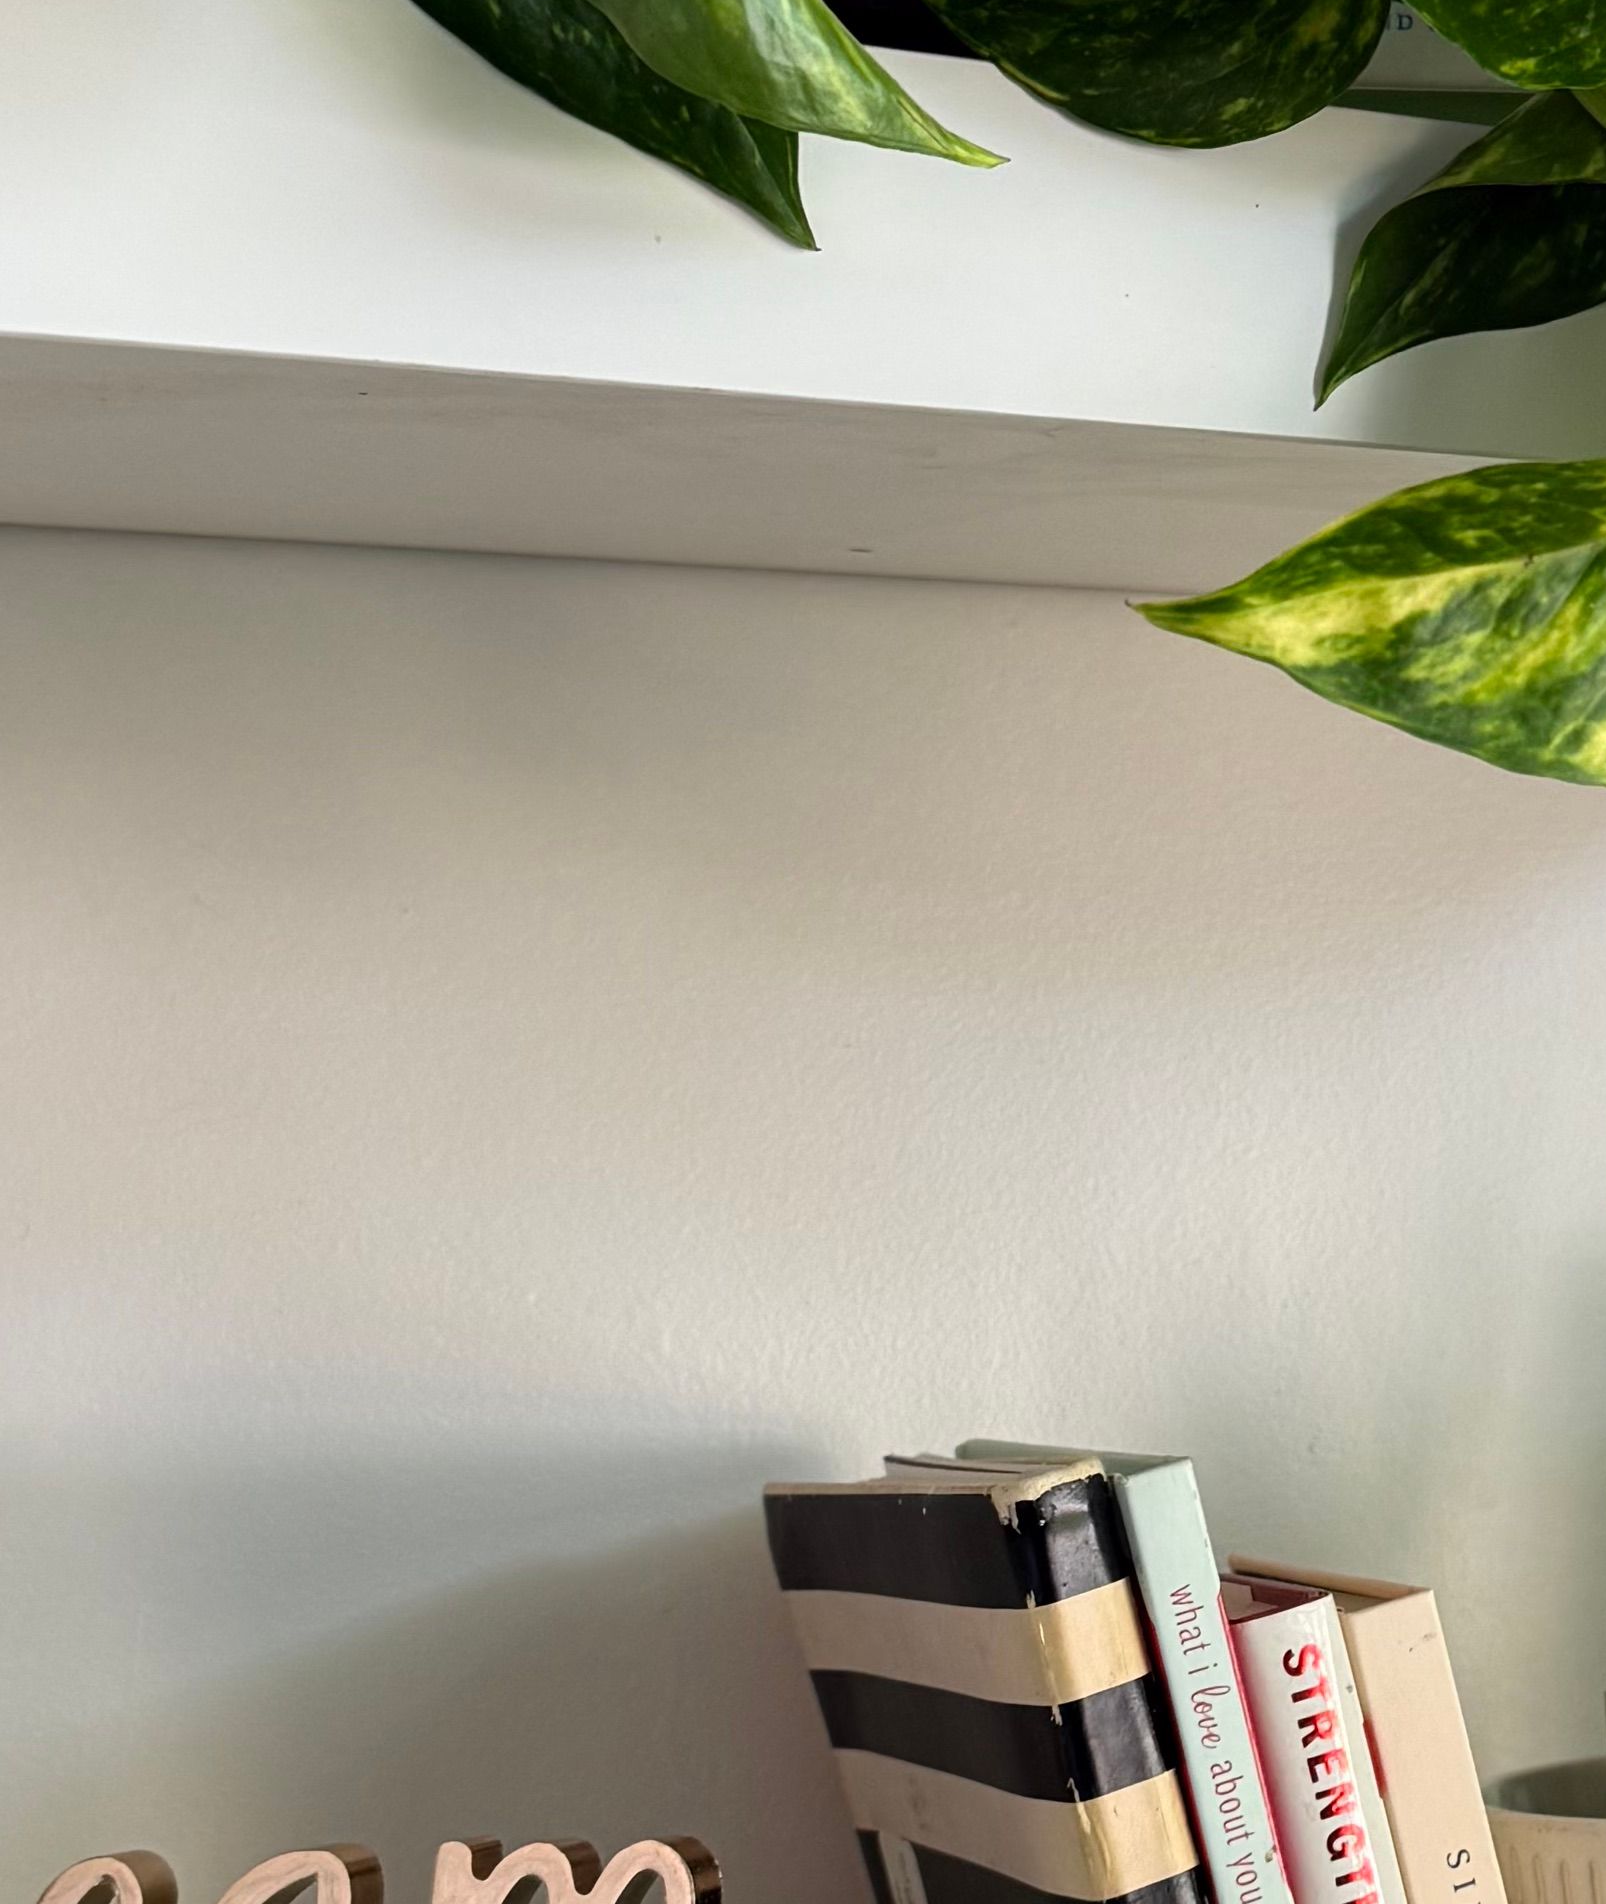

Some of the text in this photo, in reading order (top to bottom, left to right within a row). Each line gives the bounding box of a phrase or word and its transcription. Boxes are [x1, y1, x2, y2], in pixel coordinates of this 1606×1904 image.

[1170, 1584, 1211, 1656] what
[1188, 1662, 1218, 1675] i
[1191, 1685, 1231, 1749] love
[1210, 1759, 1255, 1846] about
